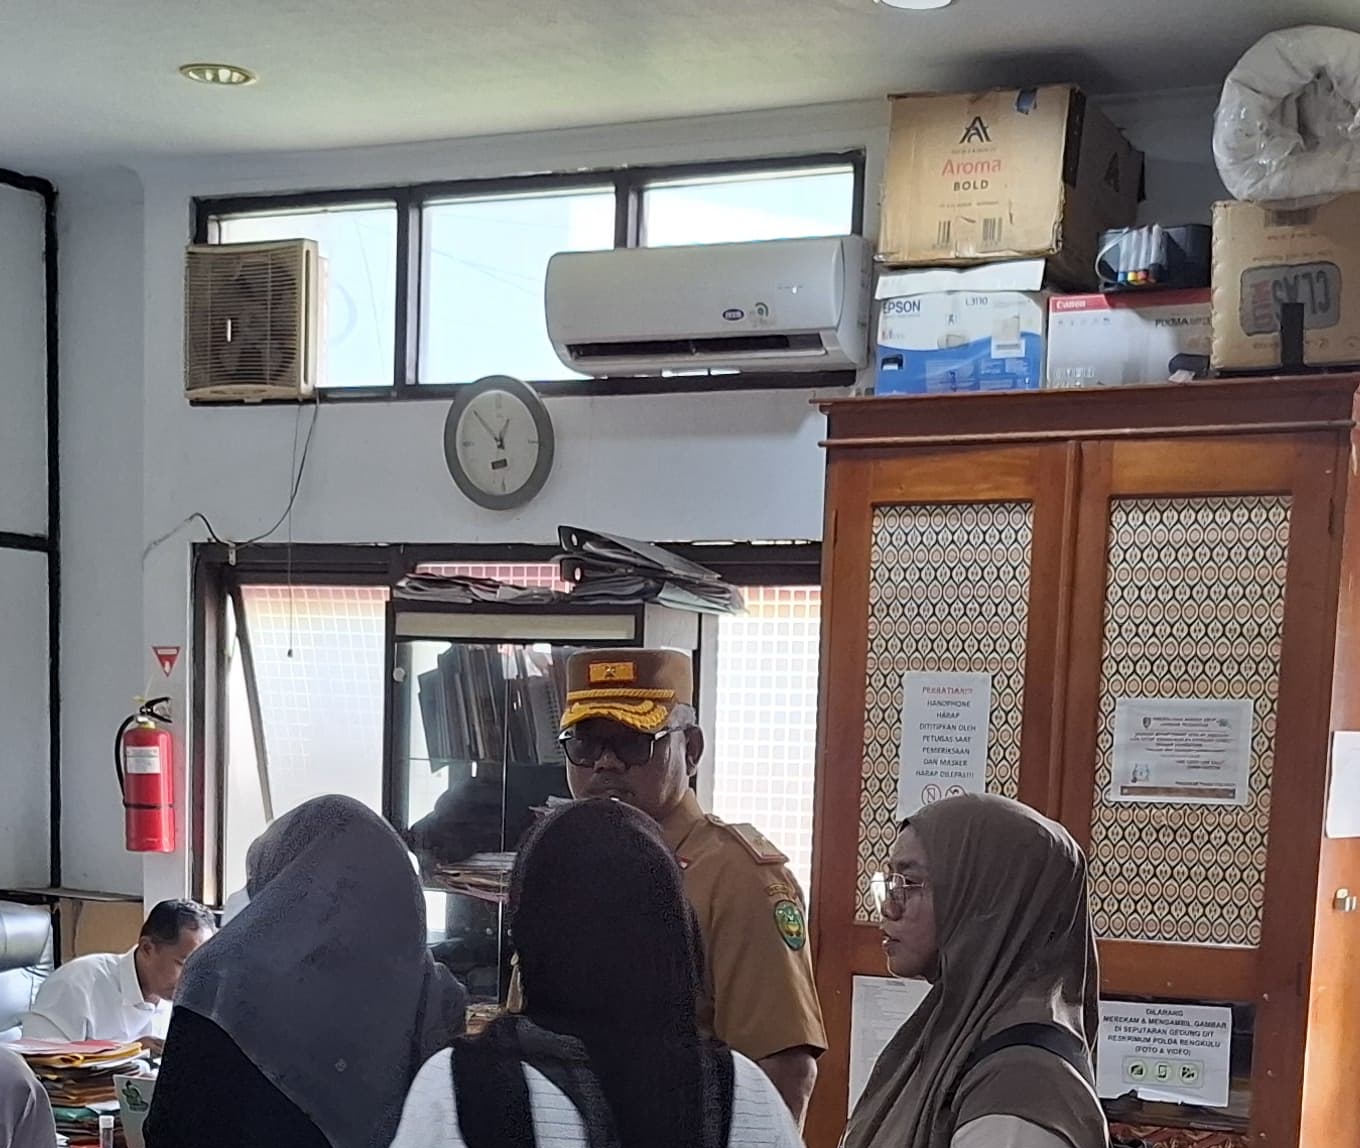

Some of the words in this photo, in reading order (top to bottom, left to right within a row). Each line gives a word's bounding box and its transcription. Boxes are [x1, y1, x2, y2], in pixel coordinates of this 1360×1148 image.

[941, 159, 1002, 177] Aroma
[953, 180, 989, 192] BOLD
[883, 299, 921, 314] EPSON
[1056, 300, 1087, 310] Canon
